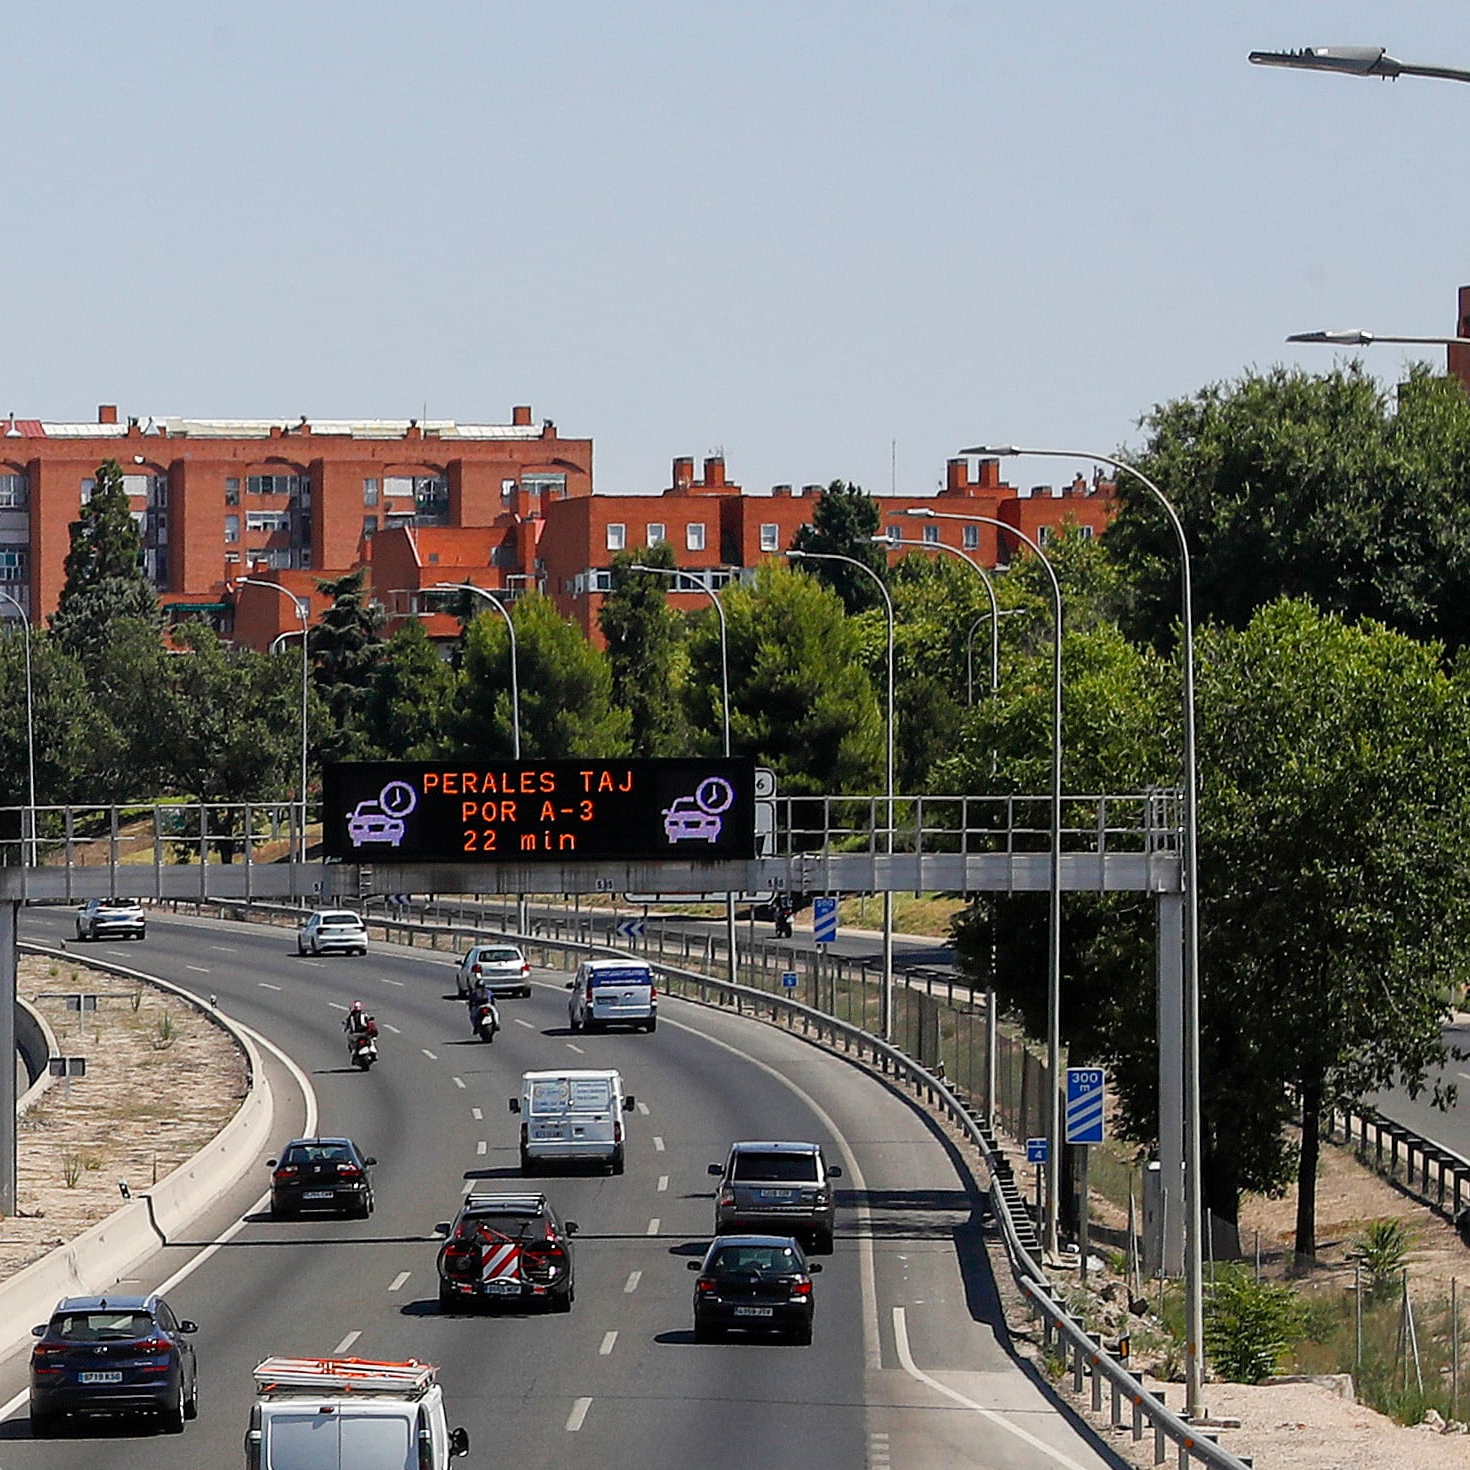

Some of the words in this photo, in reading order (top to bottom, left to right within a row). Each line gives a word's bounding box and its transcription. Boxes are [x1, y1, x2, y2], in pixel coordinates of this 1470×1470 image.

[422, 771, 555, 793] PERALES
[580, 771, 632, 791] TAJ
[462, 800, 516, 821] POR
[540, 800, 593, 820] A-3
[464, 829, 496, 850] 22
[520, 829, 575, 850] min
[1071, 1073, 1098, 1083] 300
[1079, 1084, 1090, 1092] m
